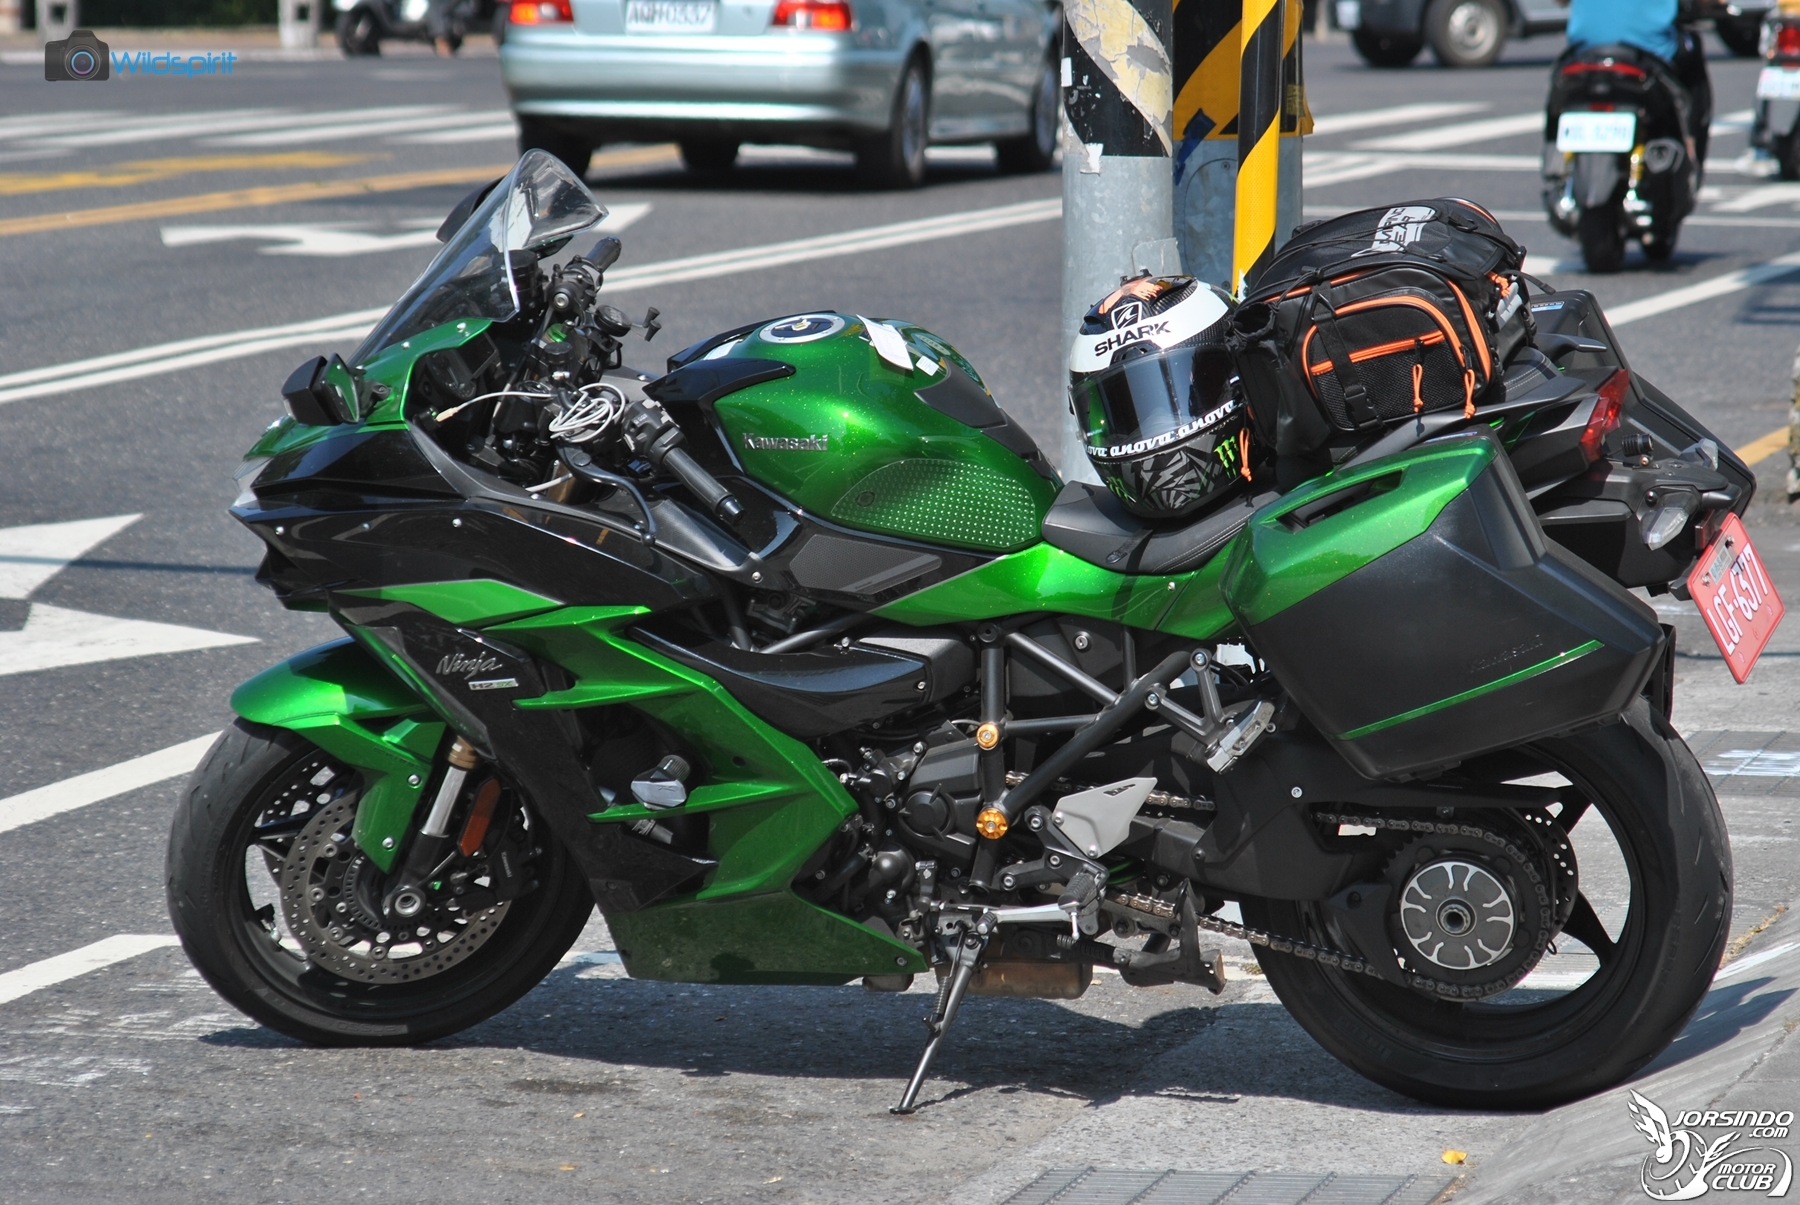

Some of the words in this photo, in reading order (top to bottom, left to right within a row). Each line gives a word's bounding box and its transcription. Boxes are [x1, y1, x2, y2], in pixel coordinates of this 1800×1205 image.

[1094, 320, 1172, 357] SHARK
[742, 432, 829, 450] Kawasaki
[1706, 542, 1769, 656] LGF-6377
[435, 651, 503, 680] Ninja
